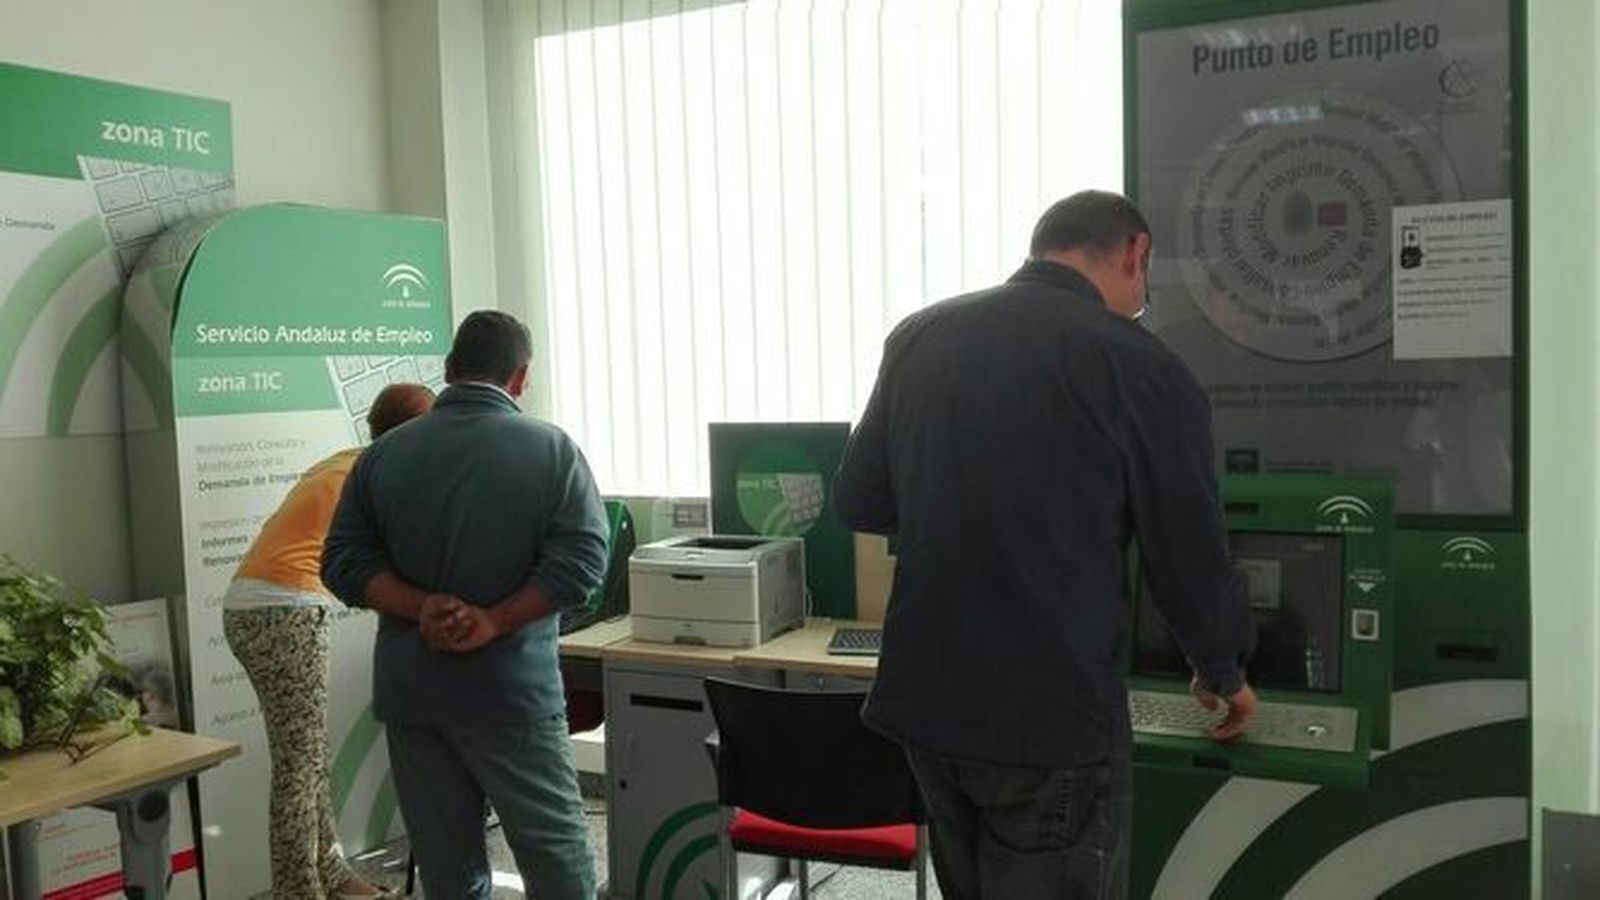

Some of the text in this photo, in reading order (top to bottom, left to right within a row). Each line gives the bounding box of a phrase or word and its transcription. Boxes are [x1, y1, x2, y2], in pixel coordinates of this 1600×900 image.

[1193, 22, 1440, 76] Punto de Empleo
[102, 119, 211, 155] zona TIC
[196, 323, 434, 346] Servicio Andaluz de Empleo
[198, 371, 283, 393] zona TIC
[198, 474, 250, 492] Demanda
[252, 474, 266, 486] de
[201, 534, 249, 549] Informes
